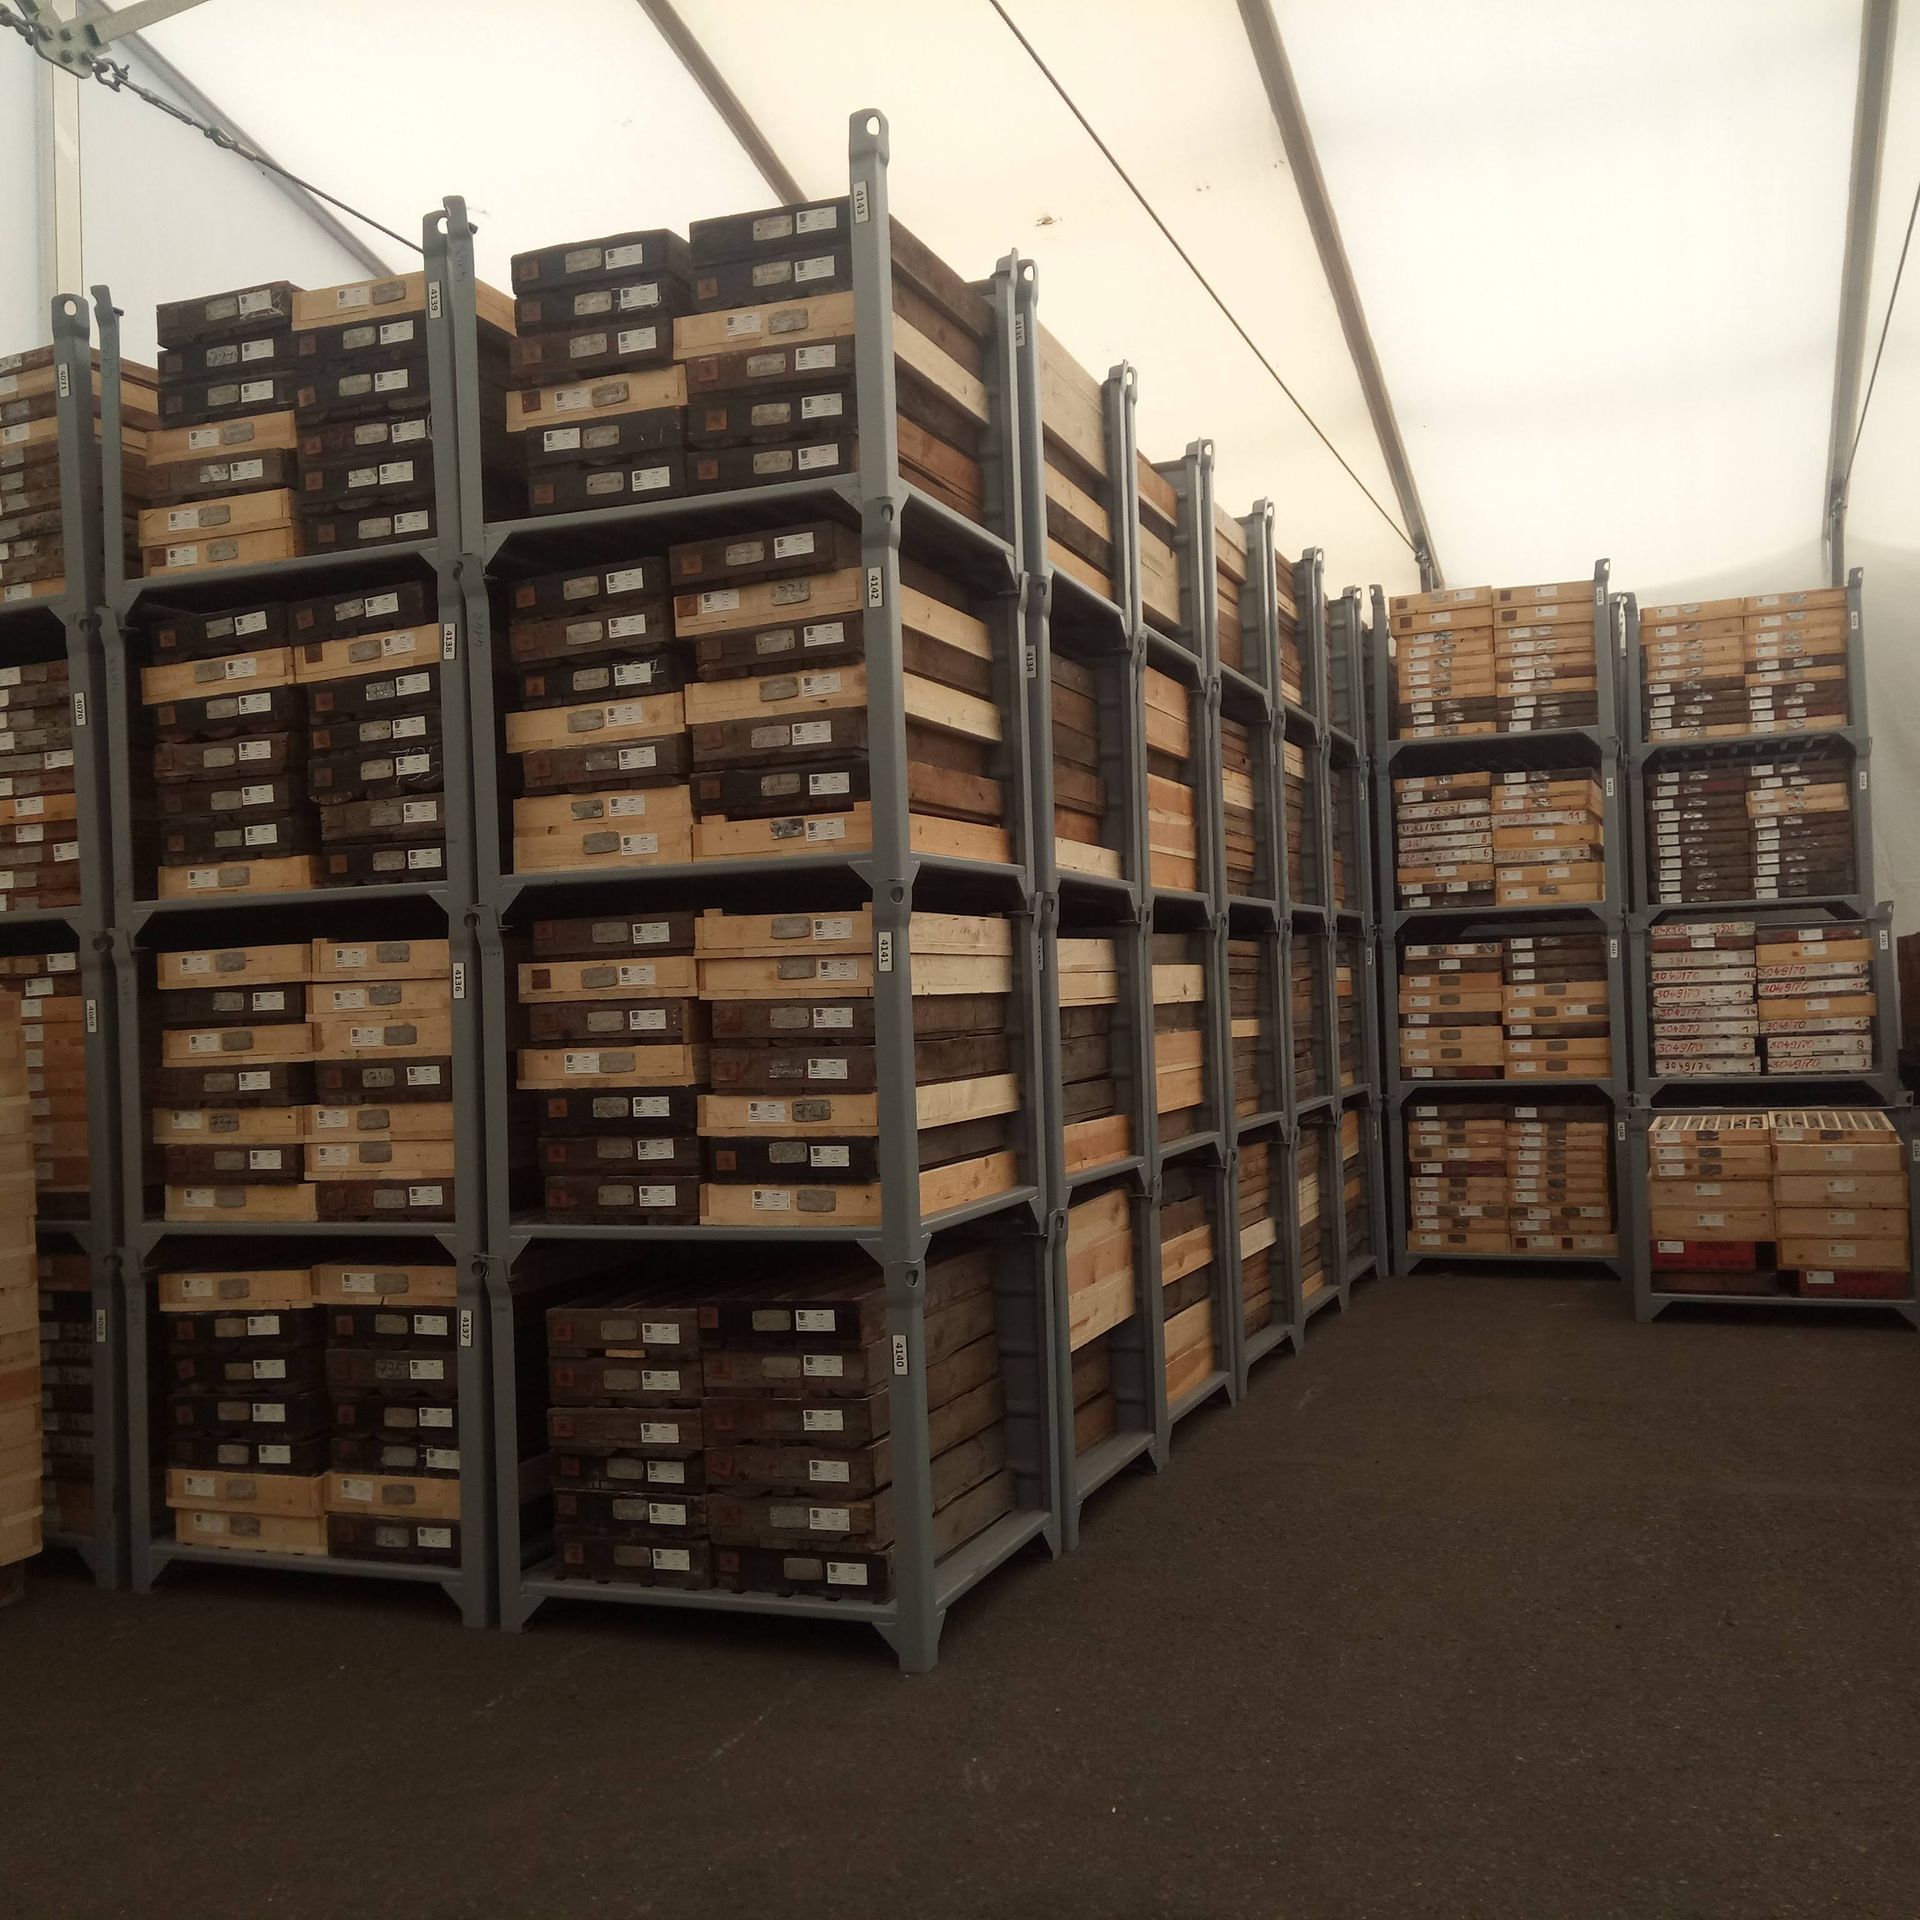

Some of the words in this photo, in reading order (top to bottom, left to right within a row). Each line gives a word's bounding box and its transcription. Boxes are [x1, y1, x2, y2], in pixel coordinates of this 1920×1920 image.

[853, 190, 866, 215] 4143
[430, 288, 439, 311] 4139
[60, 370, 68, 391] 4071
[869, 575, 879, 600] 4142
[445, 630, 453, 653] 4138
[1026, 651, 1034, 672] 4134
[76, 698, 84, 720] 4070
[880, 939, 890, 964] 4141
[454, 969, 463, 992] 4136
[1758, 965, 1807, 976] 3049/70
[1761, 981, 1809, 992] 3049/70
[462, 1316, 470, 1339] 4137
[895, 1342, 905, 1367] 4140
